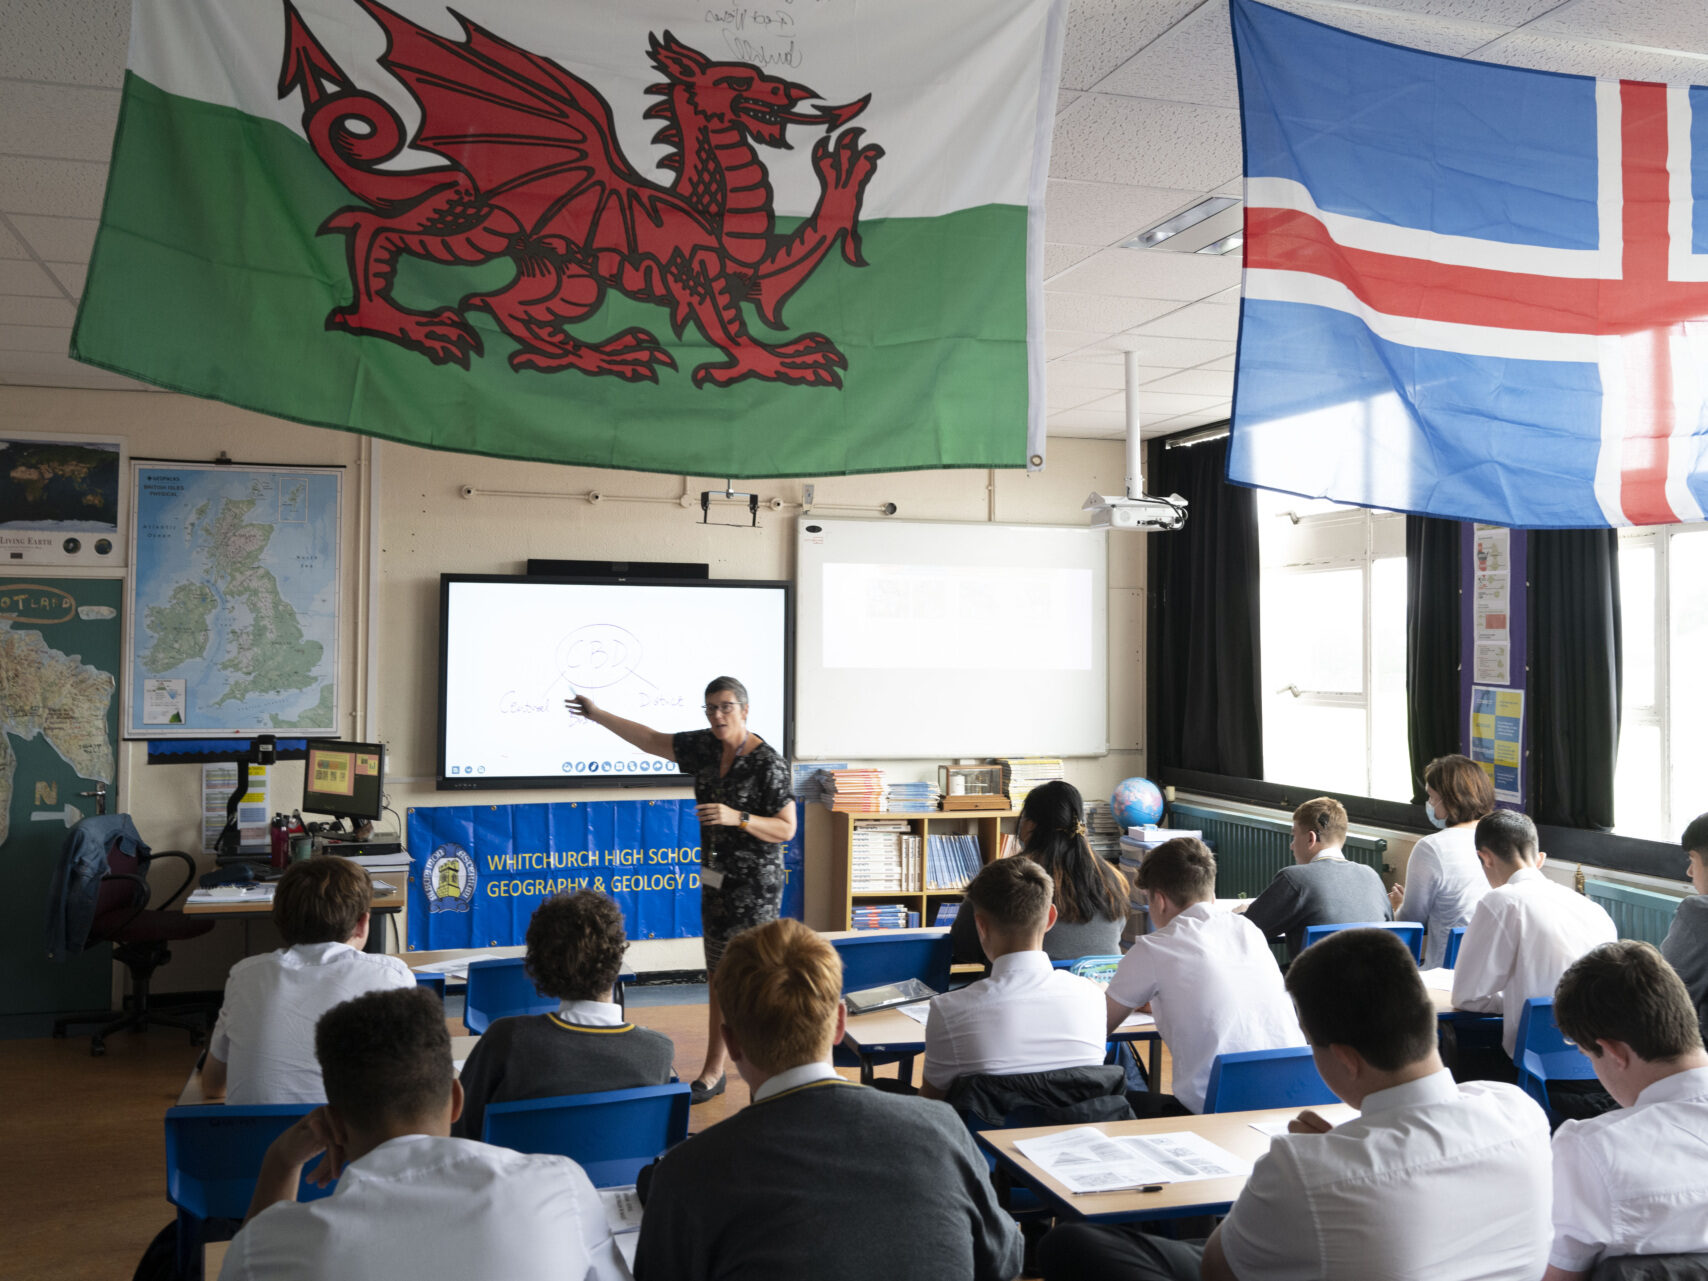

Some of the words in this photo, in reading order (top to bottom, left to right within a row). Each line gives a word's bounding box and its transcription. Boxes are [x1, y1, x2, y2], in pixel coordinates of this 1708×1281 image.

[566, 639, 628, 669] CBD
[34, 781, 58, 805] N
[487, 850, 600, 871] WHITCHURCH
[604, 848, 644, 866] HIGH
[486, 876, 589, 897] GEOGRAPHY
[593, 876, 606, 893] &
[611, 874, 685, 892] GEOLOGY
